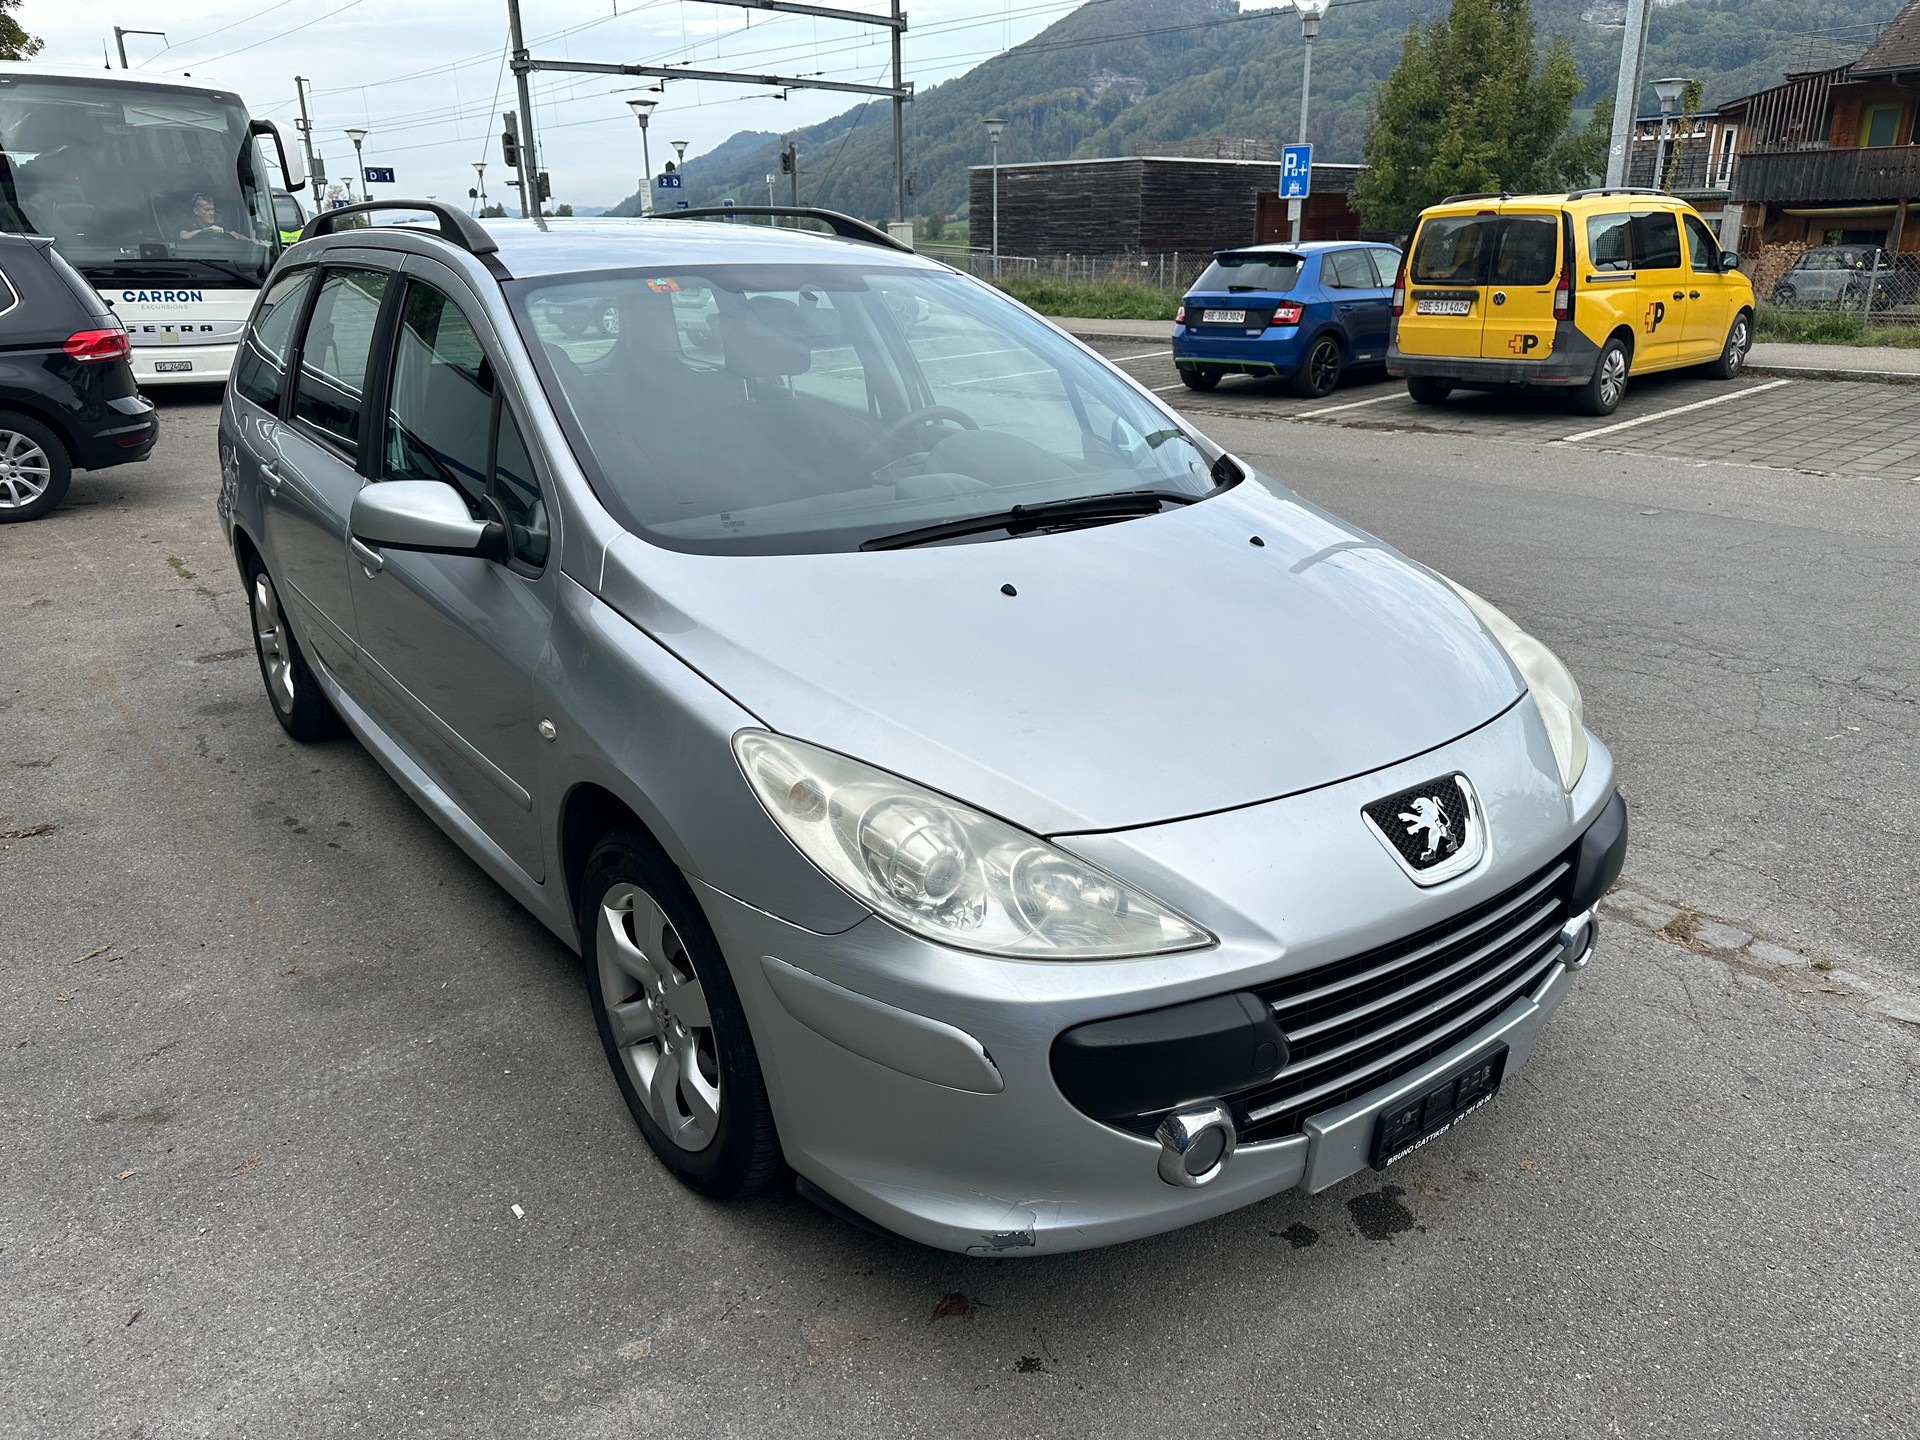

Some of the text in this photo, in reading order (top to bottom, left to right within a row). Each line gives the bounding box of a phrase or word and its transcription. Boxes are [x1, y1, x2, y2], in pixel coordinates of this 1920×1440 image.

[370, 172, 377, 180] D
[662, 178, 668, 186] 2
[122, 290, 203, 303] CARRON
[1387, 1145, 1414, 1167] BRUNO
[1415, 1123, 1450, 1150] GATTIKER
